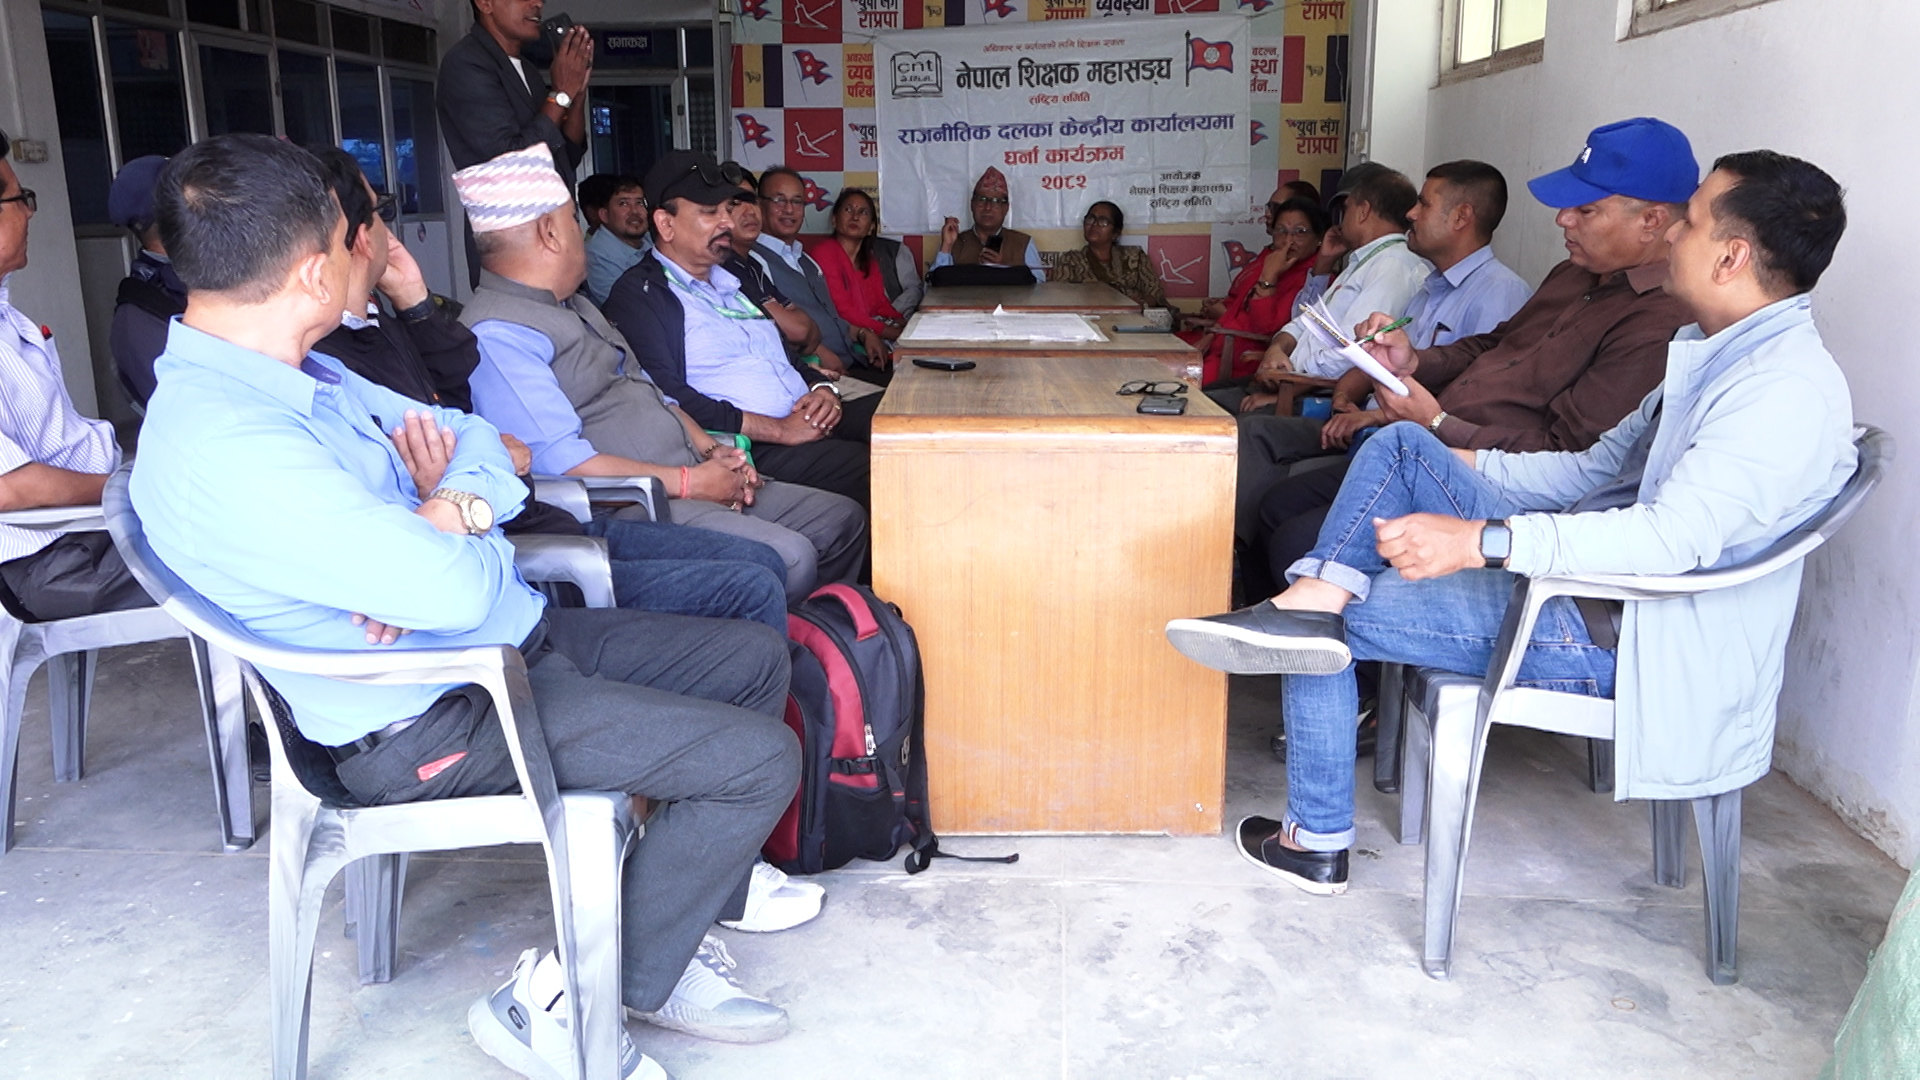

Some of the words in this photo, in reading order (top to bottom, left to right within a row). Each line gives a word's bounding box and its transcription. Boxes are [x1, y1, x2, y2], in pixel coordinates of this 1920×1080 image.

[857, 11, 899, 29] राप्रपा
[955, 60, 1012, 90] नेपाल
[1017, 57, 1081, 88] शिक्षक
[897, 121, 992, 145] राजनीतिक
[998, 122, 1053, 141] दलका
[1059, 115, 1125, 138] केन्द्रीय
[1130, 112, 1235, 134] कार्यालयमा
[1045, 143, 1126, 164] कार्यक्रम
[1295, 137, 1340, 154] राप्रपा
[1041, 174, 1088, 191] २०८२
[1159, 169, 1202, 182] आयोजक
